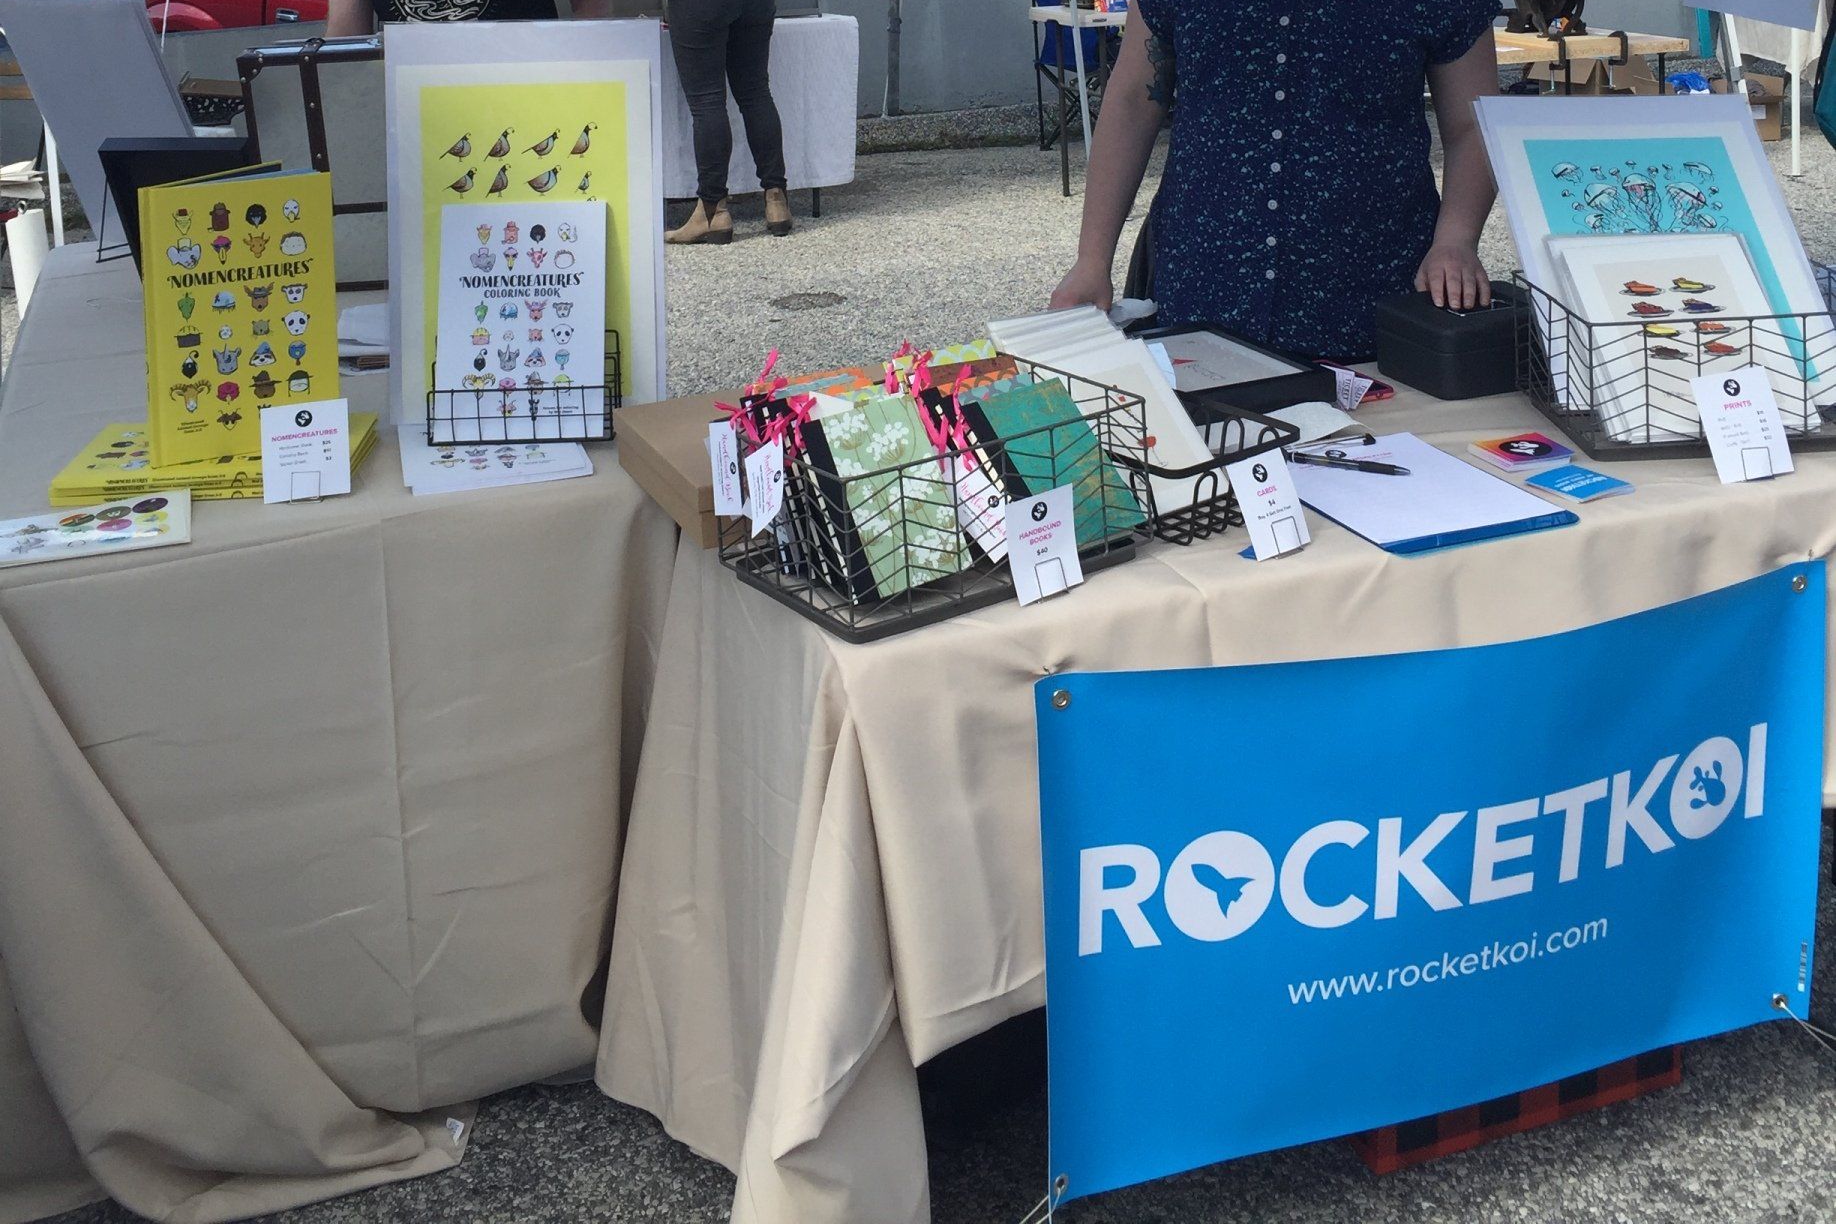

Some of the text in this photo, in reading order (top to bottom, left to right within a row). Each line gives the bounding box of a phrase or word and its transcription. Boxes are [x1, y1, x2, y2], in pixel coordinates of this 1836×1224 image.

[166, 257, 314, 289] NOMENCREATURES
[459, 271, 585, 289] NOMENCREATURES
[483, 287, 562, 299] COLORING BOOK
[1723, 399, 1752, 411] PRINTS
[271, 428, 339, 442] NOMENCREATURES
[1256, 485, 1277, 497] CARDS
[1019, 520, 1062, 540] HANDBOUND
[1029, 532, 1052, 545] BOOKS
[1036, 546, 1049, 557] $40
[1078, 722, 1768, 957] ROCKETKOI
[1286, 917, 1609, 1005] www.rocketkoi.com
